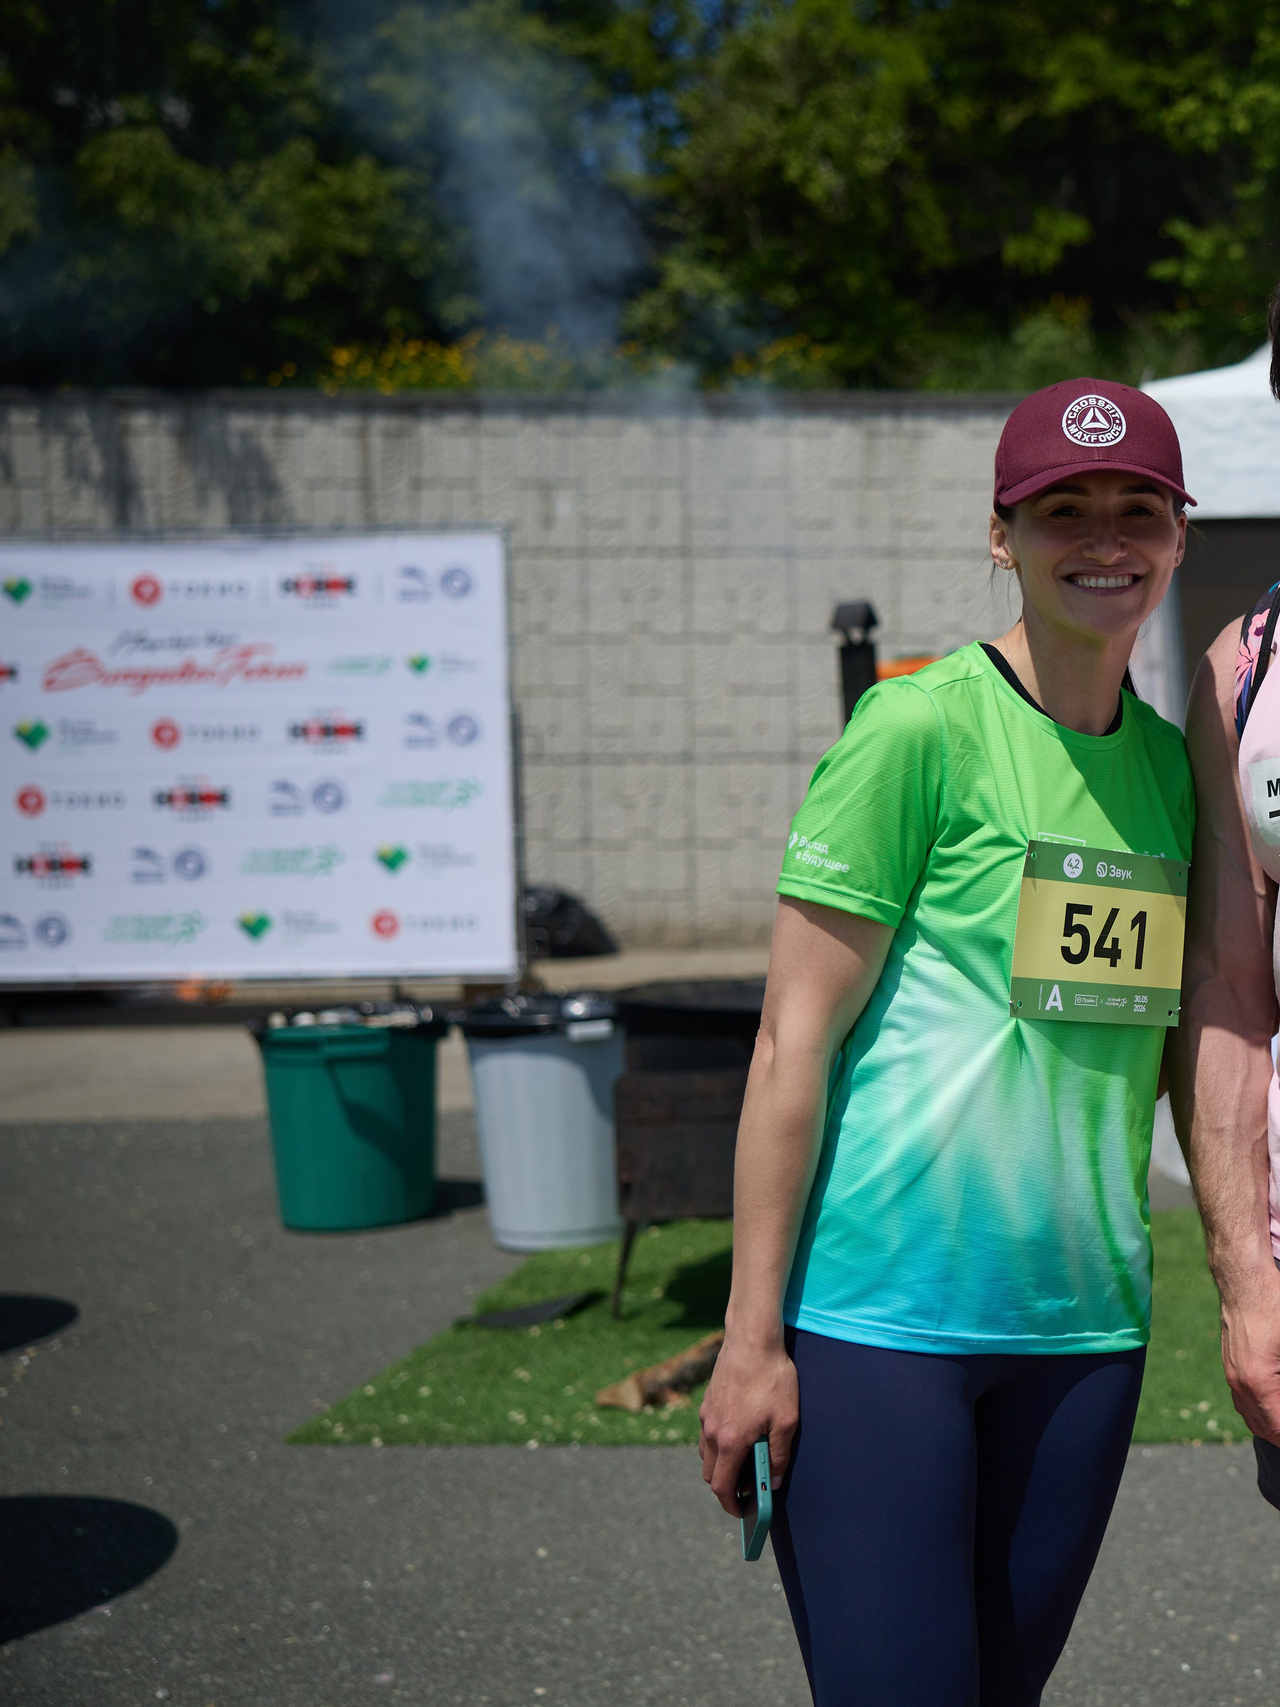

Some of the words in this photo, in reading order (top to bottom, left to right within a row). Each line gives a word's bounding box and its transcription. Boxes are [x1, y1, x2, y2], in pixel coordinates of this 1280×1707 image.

[1068, 398, 1120, 419] CROSSFIT
[1067, 423, 1121, 443] MAXFORCE
[798, 836, 829, 855] Вклад
[795, 851, 801, 860] в
[801, 850, 850, 873] будущее
[1067, 858, 1080, 870] 4,2
[1109, 865, 1132, 880] Звук
[1060, 902, 1147, 970] 541
[1133, 1004, 1147, 1012] 2026
